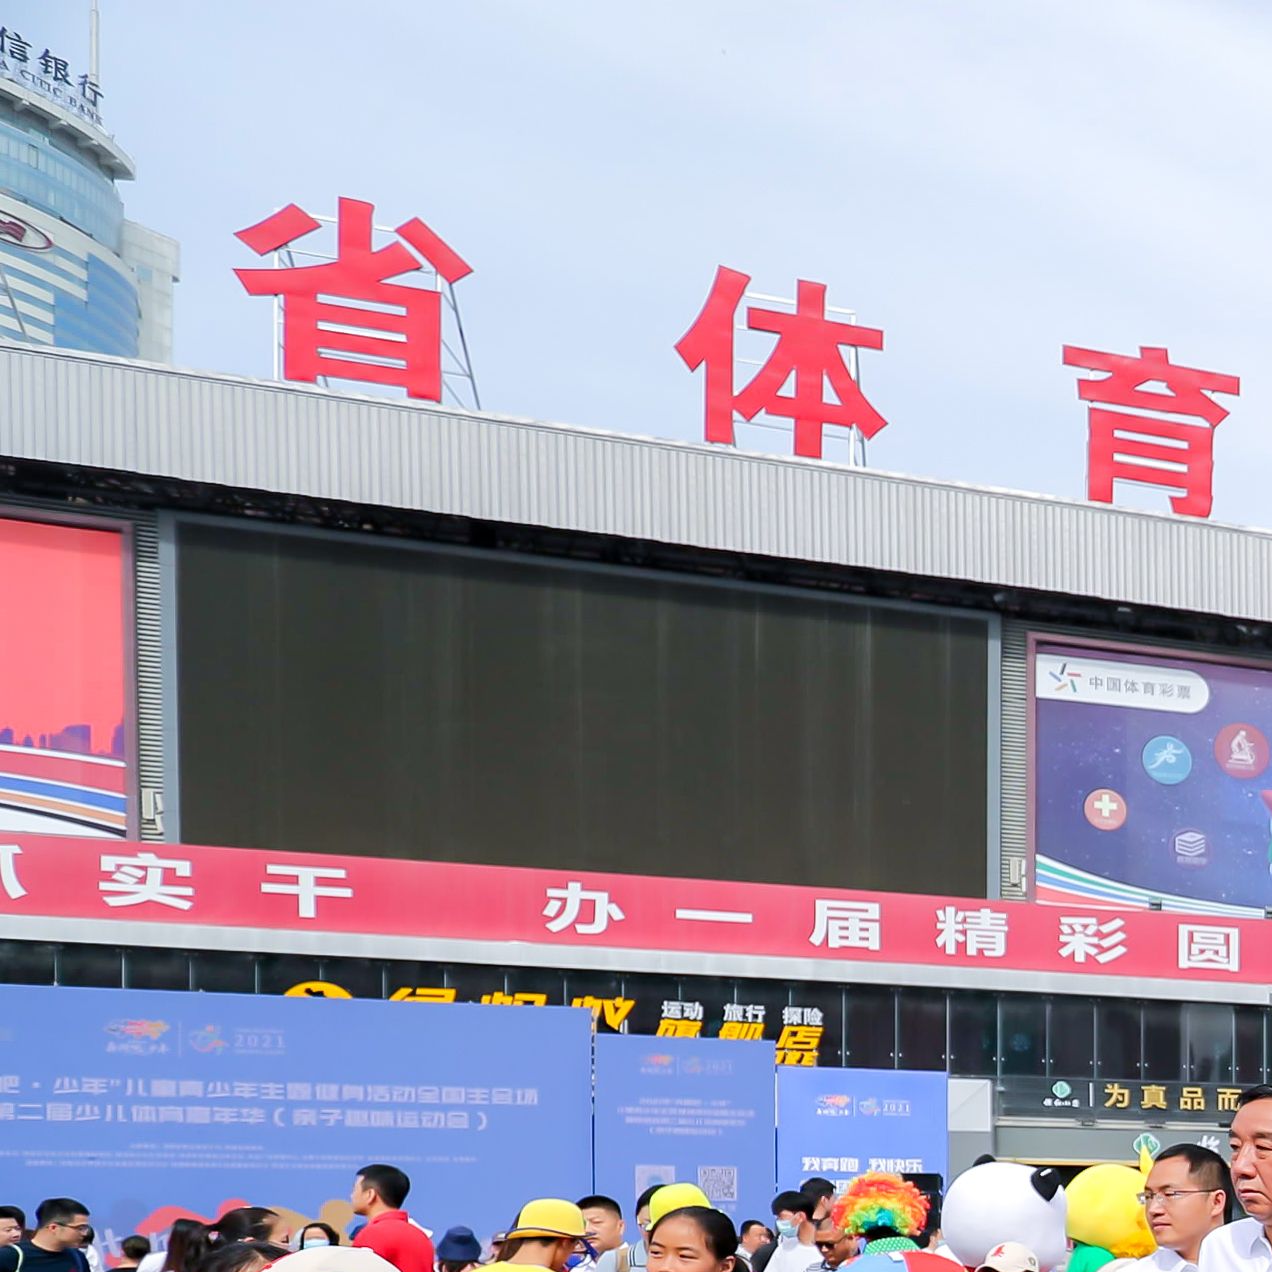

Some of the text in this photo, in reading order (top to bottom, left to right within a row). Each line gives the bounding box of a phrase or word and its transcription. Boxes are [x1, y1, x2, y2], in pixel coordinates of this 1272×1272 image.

[1089, 675, 1192, 700] 中国体育彩票
[661, 1000, 824, 1025] 运动 旅行 探险
[1104, 1083, 1242, 1111] 为真品而
